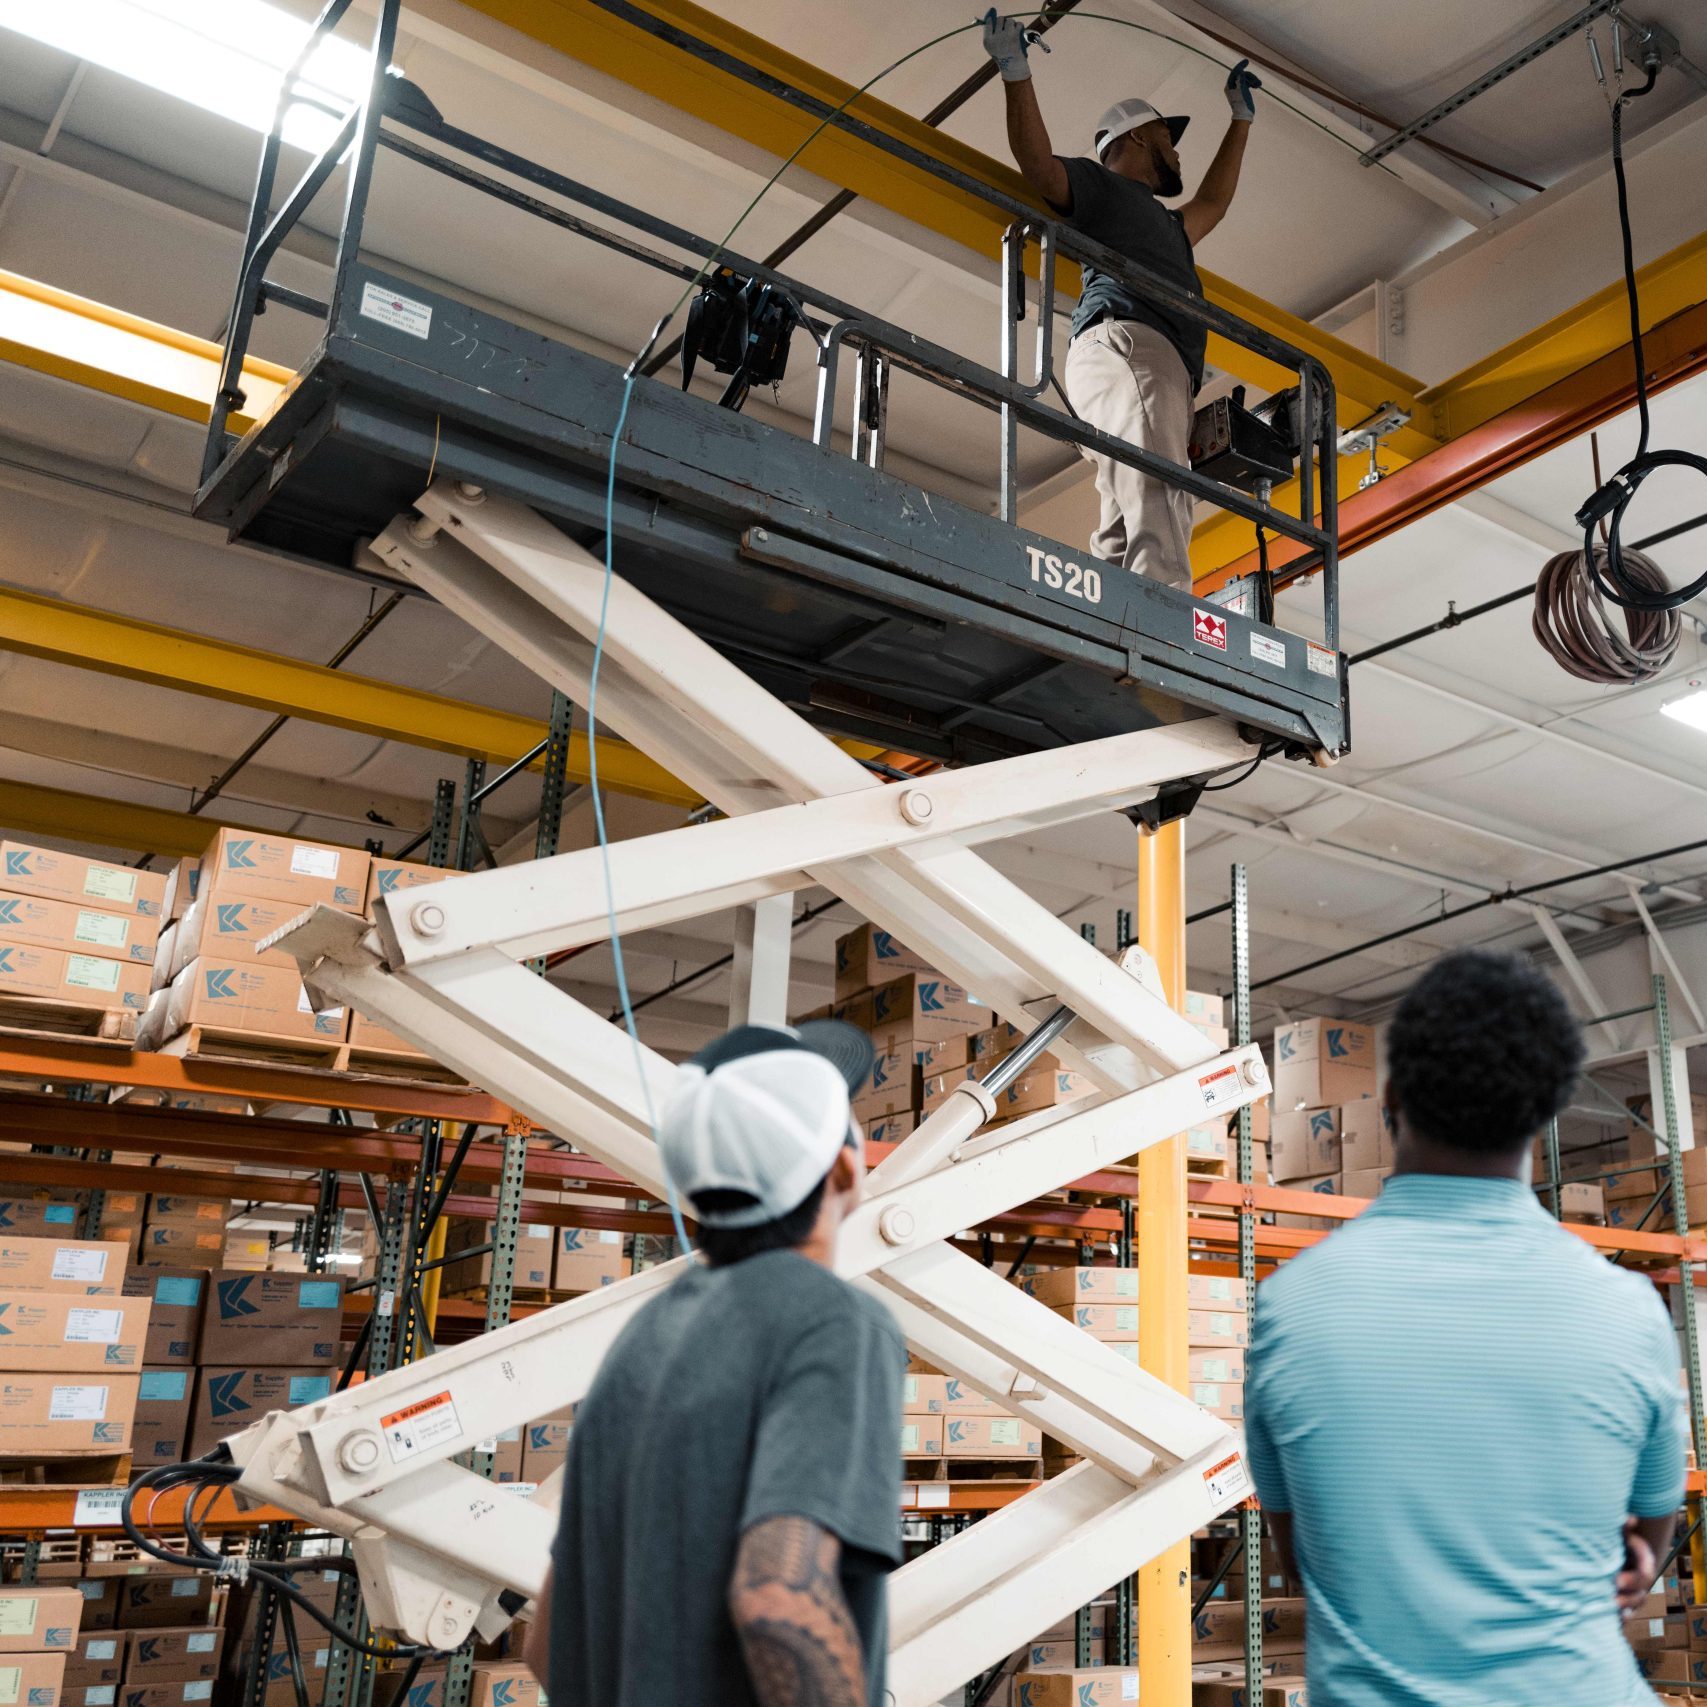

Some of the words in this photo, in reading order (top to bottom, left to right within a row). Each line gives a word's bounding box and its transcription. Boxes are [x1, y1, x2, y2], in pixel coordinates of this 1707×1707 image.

[1027, 545, 1102, 604] TS20
[1196, 631, 1225, 648] TEREX
[400, 1396, 443, 1420] WARNING
